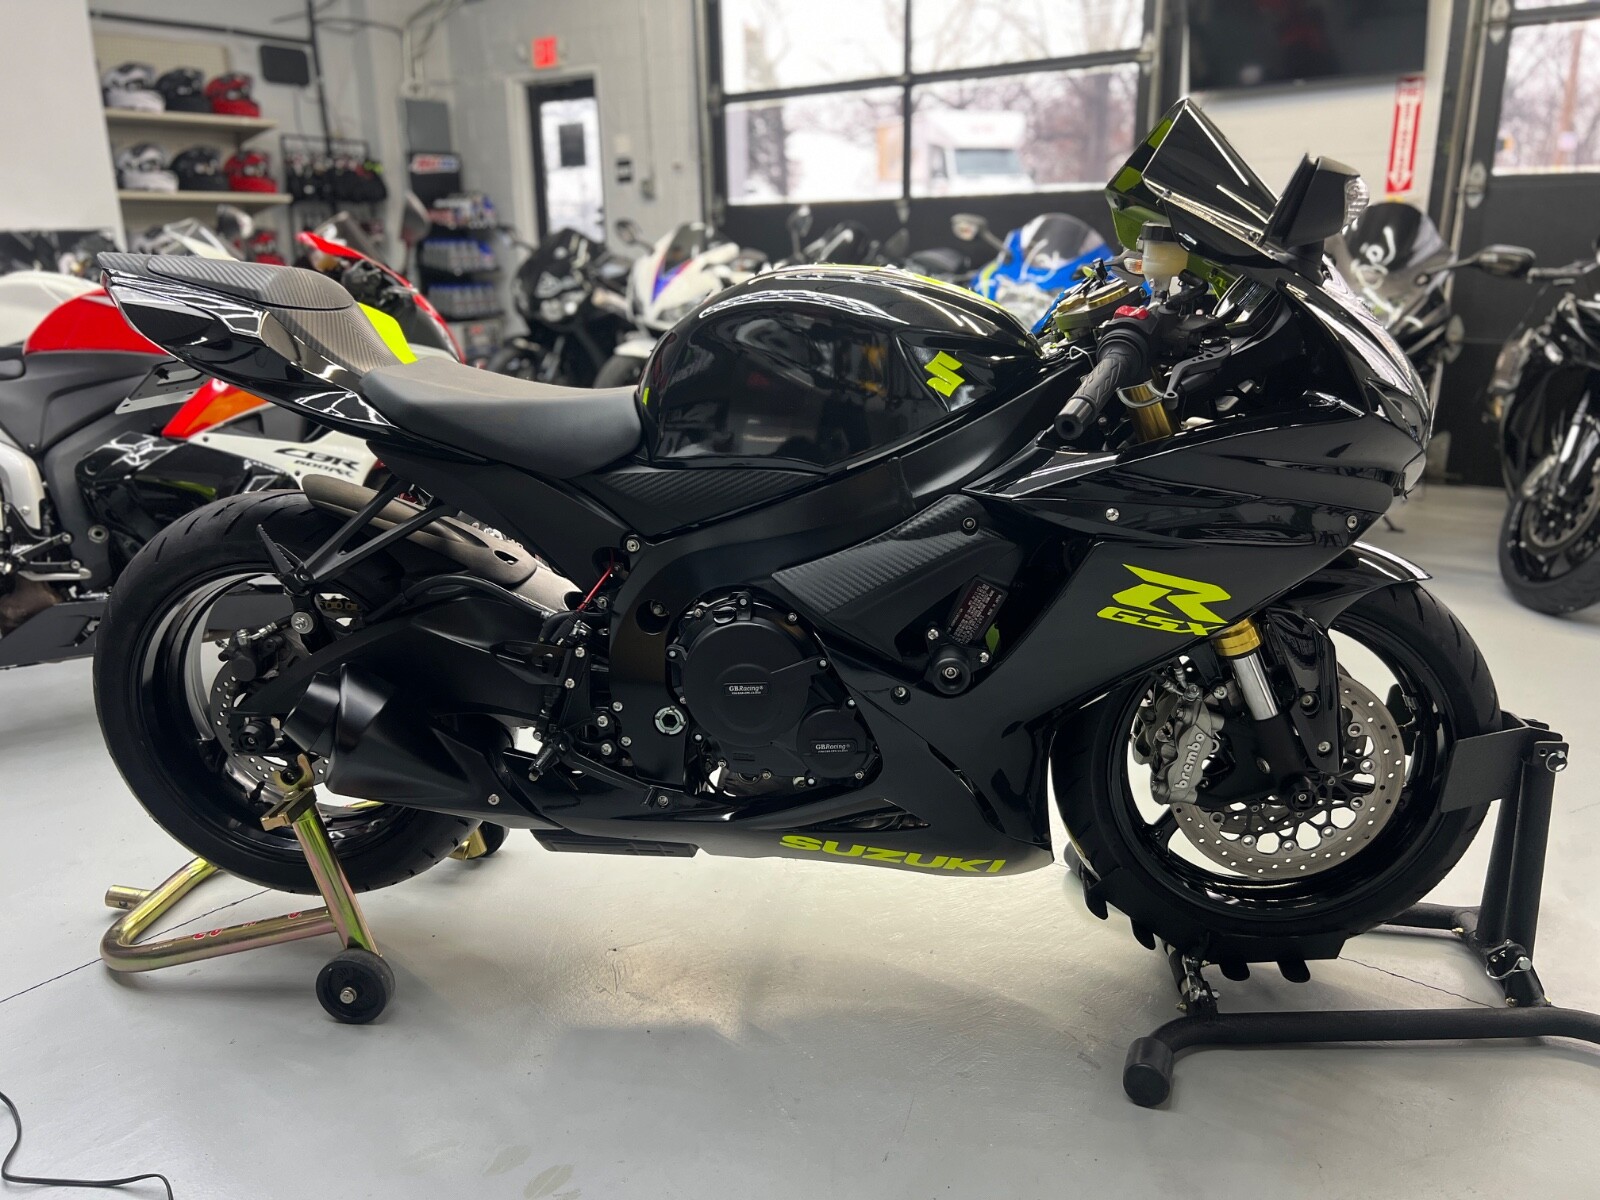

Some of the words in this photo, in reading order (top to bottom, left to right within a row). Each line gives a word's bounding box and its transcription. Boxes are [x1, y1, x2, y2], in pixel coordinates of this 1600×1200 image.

[274, 448, 359, 471] CBR
[1112, 563, 1231, 623] R
[1096, 606, 1224, 636] GSX
[1174, 733, 1205, 788] brembo
[779, 835, 1006, 873] SUZUKI
